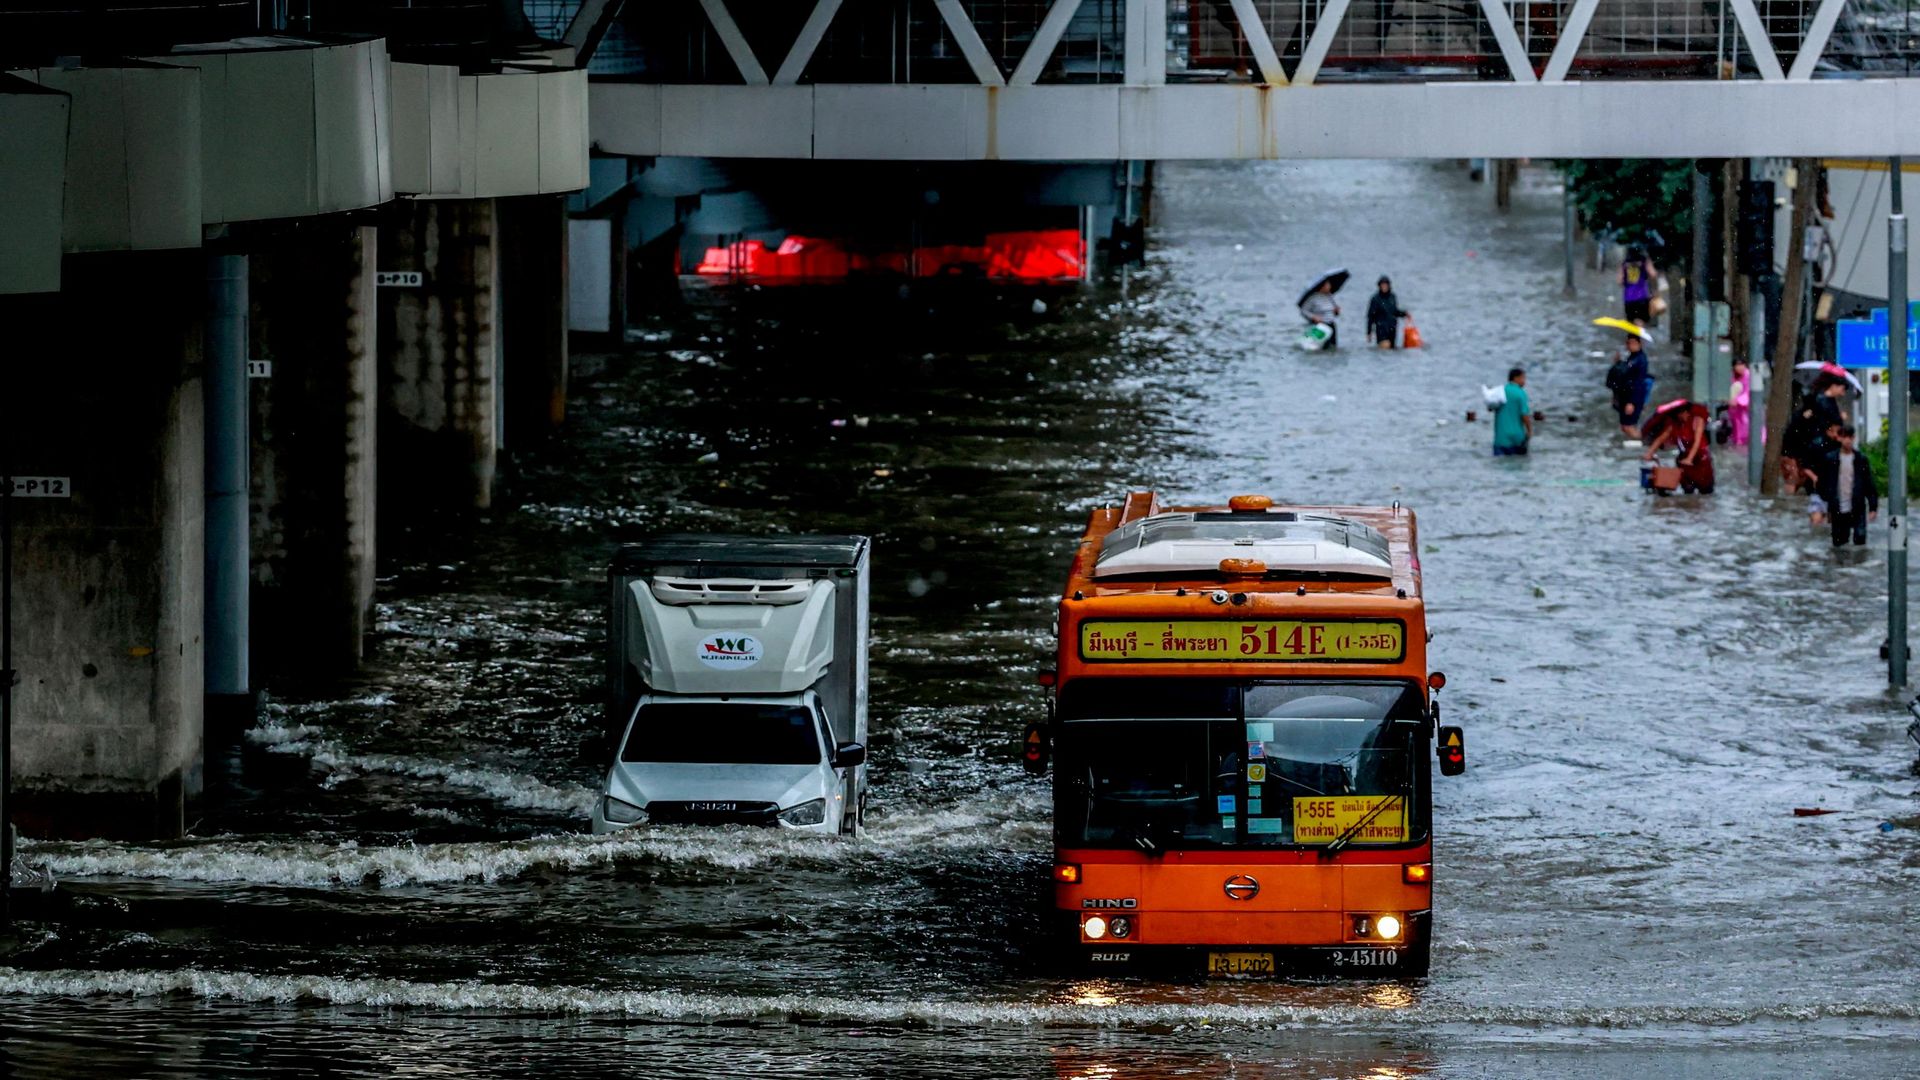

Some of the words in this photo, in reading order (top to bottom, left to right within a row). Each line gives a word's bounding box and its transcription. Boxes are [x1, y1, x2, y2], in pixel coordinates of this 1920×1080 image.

[715, 638, 753, 652] WC
[1089, 631, 1137, 656] มีนบุรี
[1162, 624, 1227, 651] สี่พระยา
[1240, 624, 1326, 655] 514E
[1336, 634, 1396, 651] (1-55E)
[1296, 801, 1335, 818] 1-55E
[1295, 821, 1339, 839] (ทางด่วน)
[1083, 899, 1136, 908] HINO
[1333, 950, 1397, 966] 2-45110
